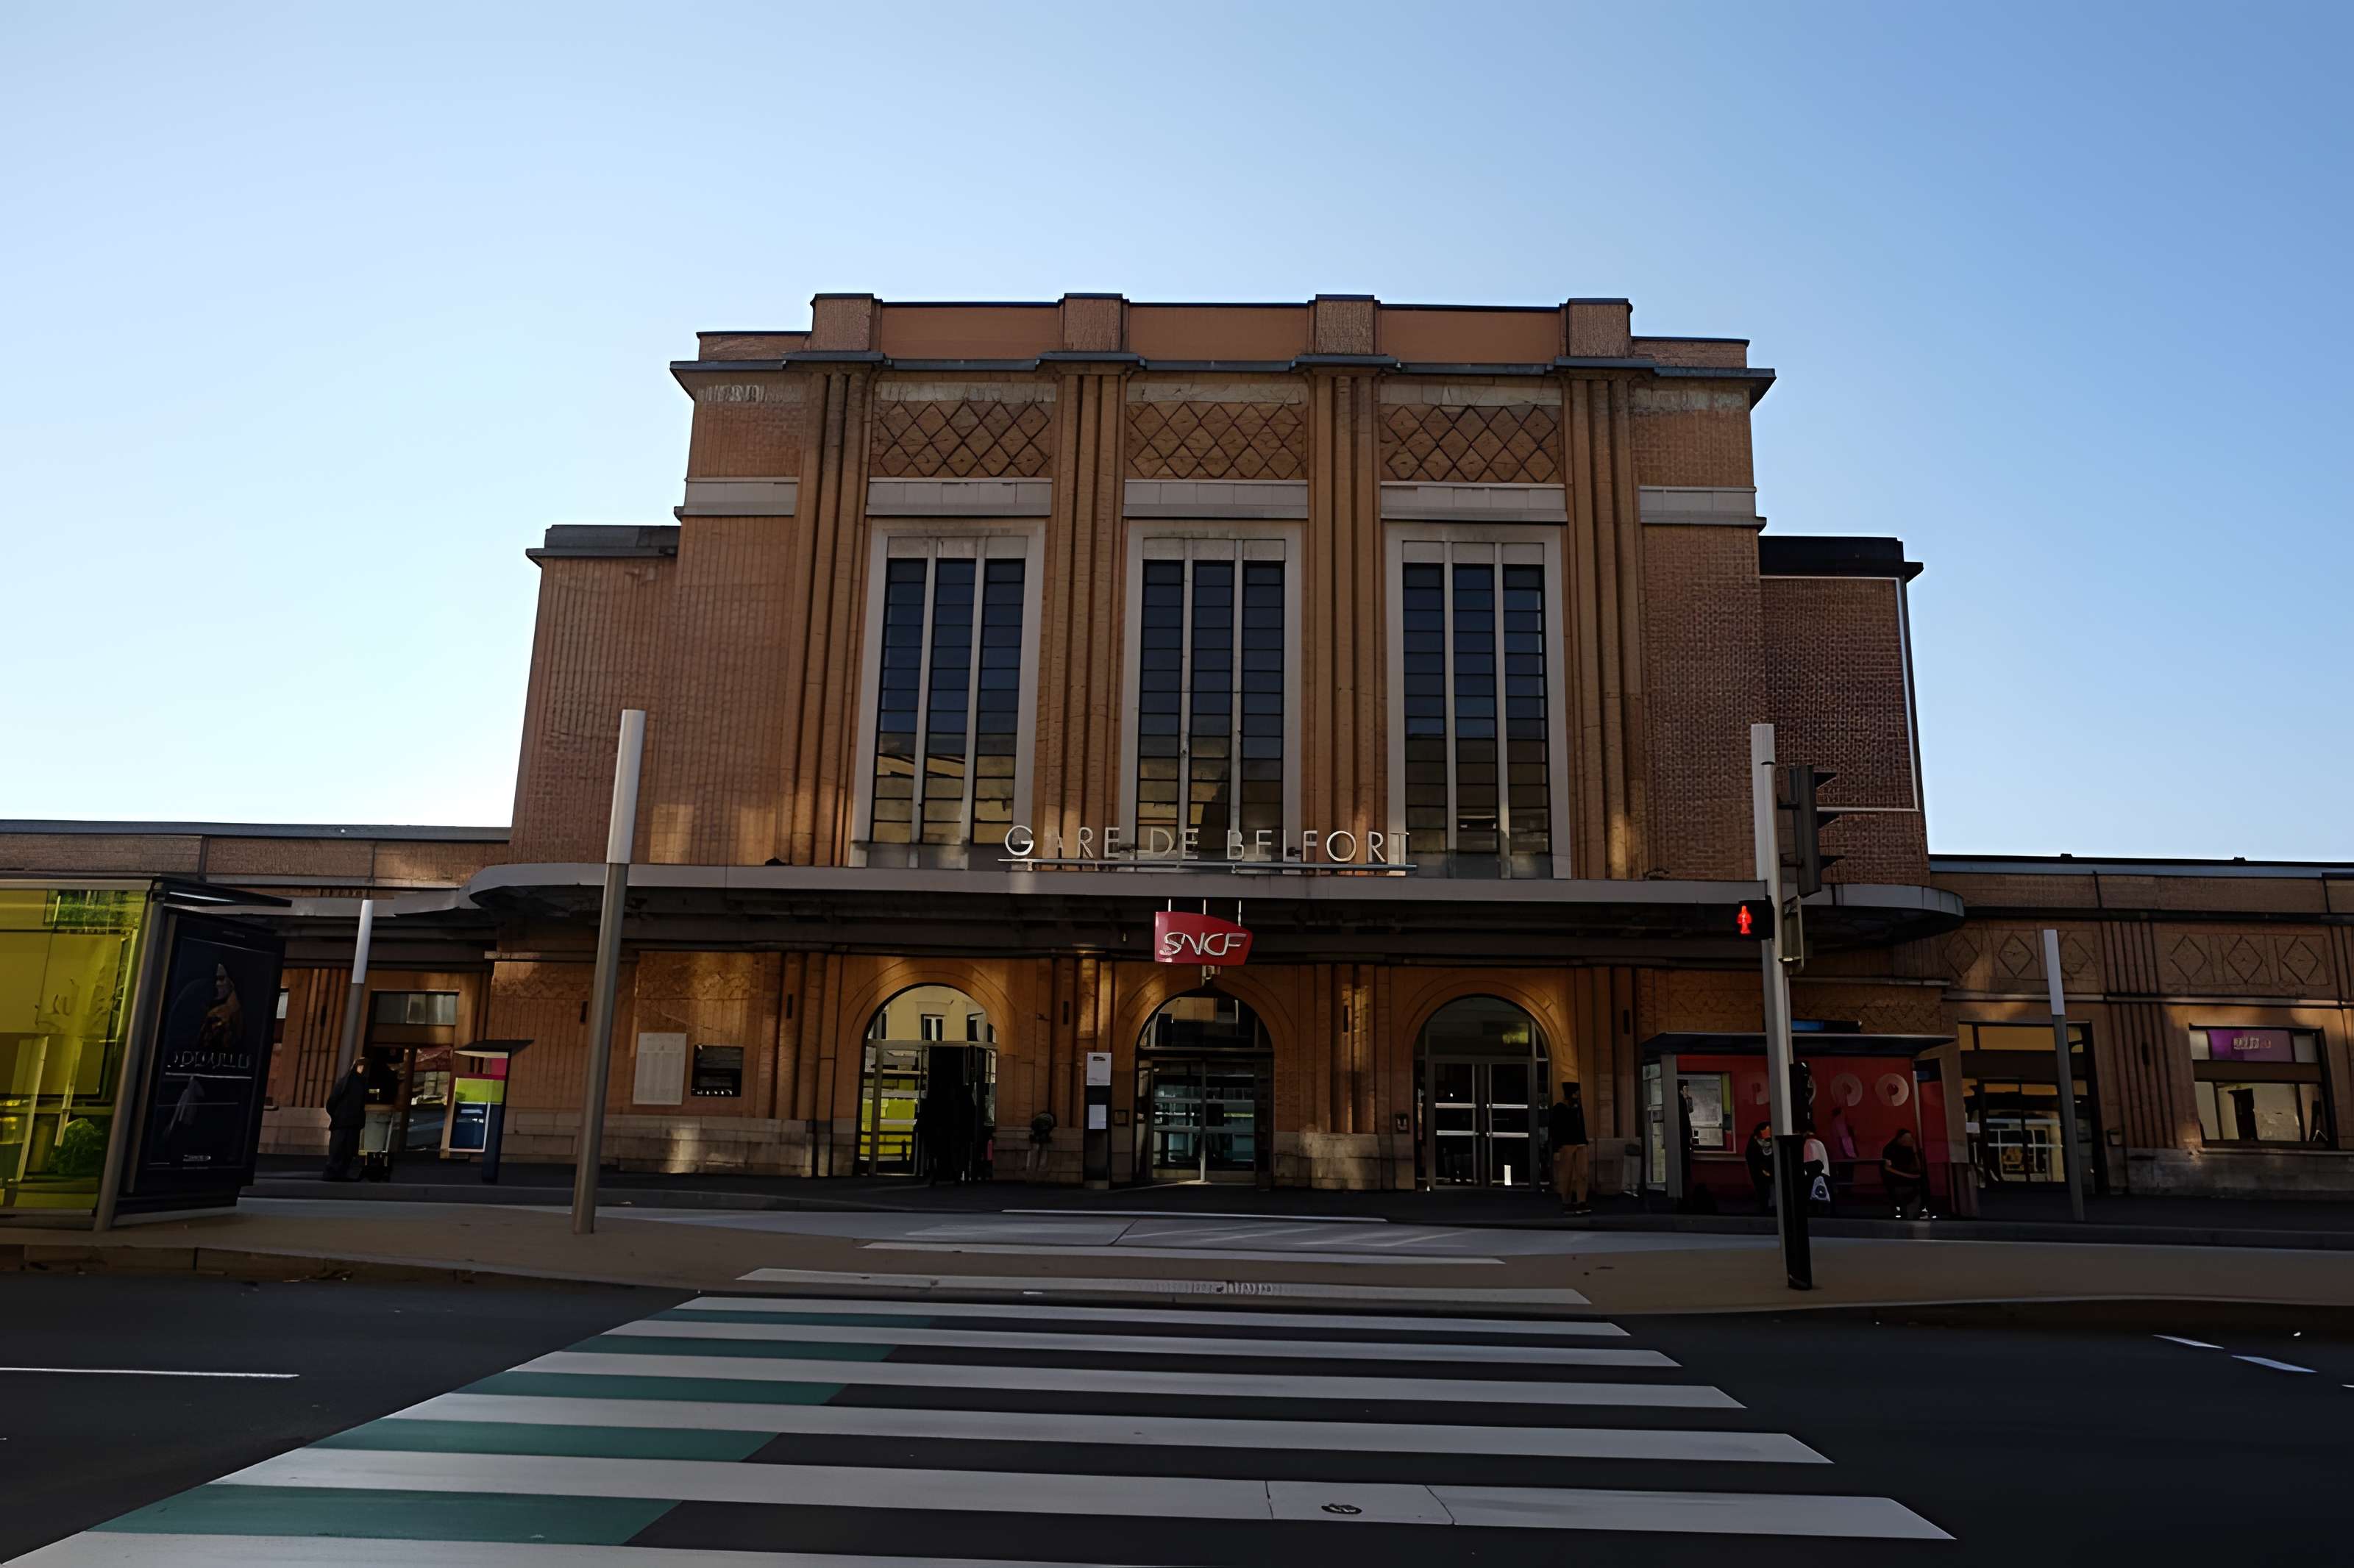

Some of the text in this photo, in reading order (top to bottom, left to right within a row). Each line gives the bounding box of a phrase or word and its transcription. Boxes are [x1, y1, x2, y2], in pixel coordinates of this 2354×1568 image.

[1005, 825, 1410, 864] GARE DE BELFORT
[1159, 930, 1247, 957] SNCF
